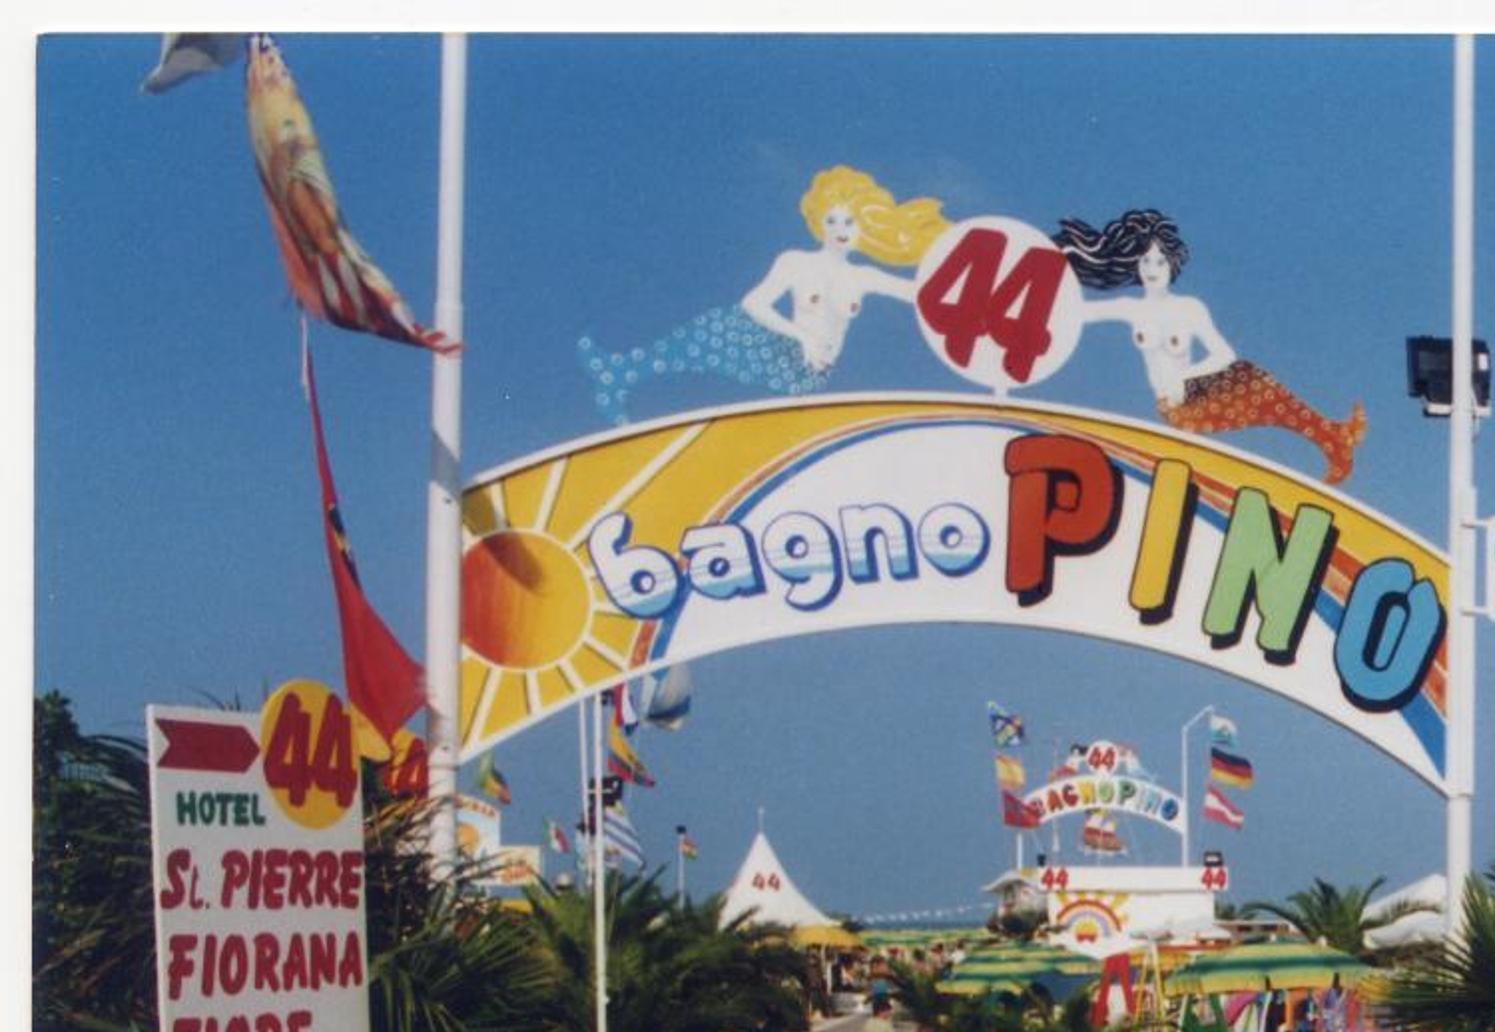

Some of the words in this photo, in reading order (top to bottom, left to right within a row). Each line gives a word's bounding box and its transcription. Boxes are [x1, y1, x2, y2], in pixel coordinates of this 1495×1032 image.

[916, 229, 1071, 384] 44
[588, 500, 990, 618] bagno
[1004, 434, 1447, 712] PINO
[263, 692, 358, 808] 44
[1088, 746, 1116, 772] 44
[176, 792, 266, 827] HOTEL
[220, 849, 363, 911] PIERRE
[753, 873, 781, 891] 44
[1041, 868, 1069, 890] 44
[1202, 868, 1227, 890] 44
[167, 931, 364, 1001] FIORANA
